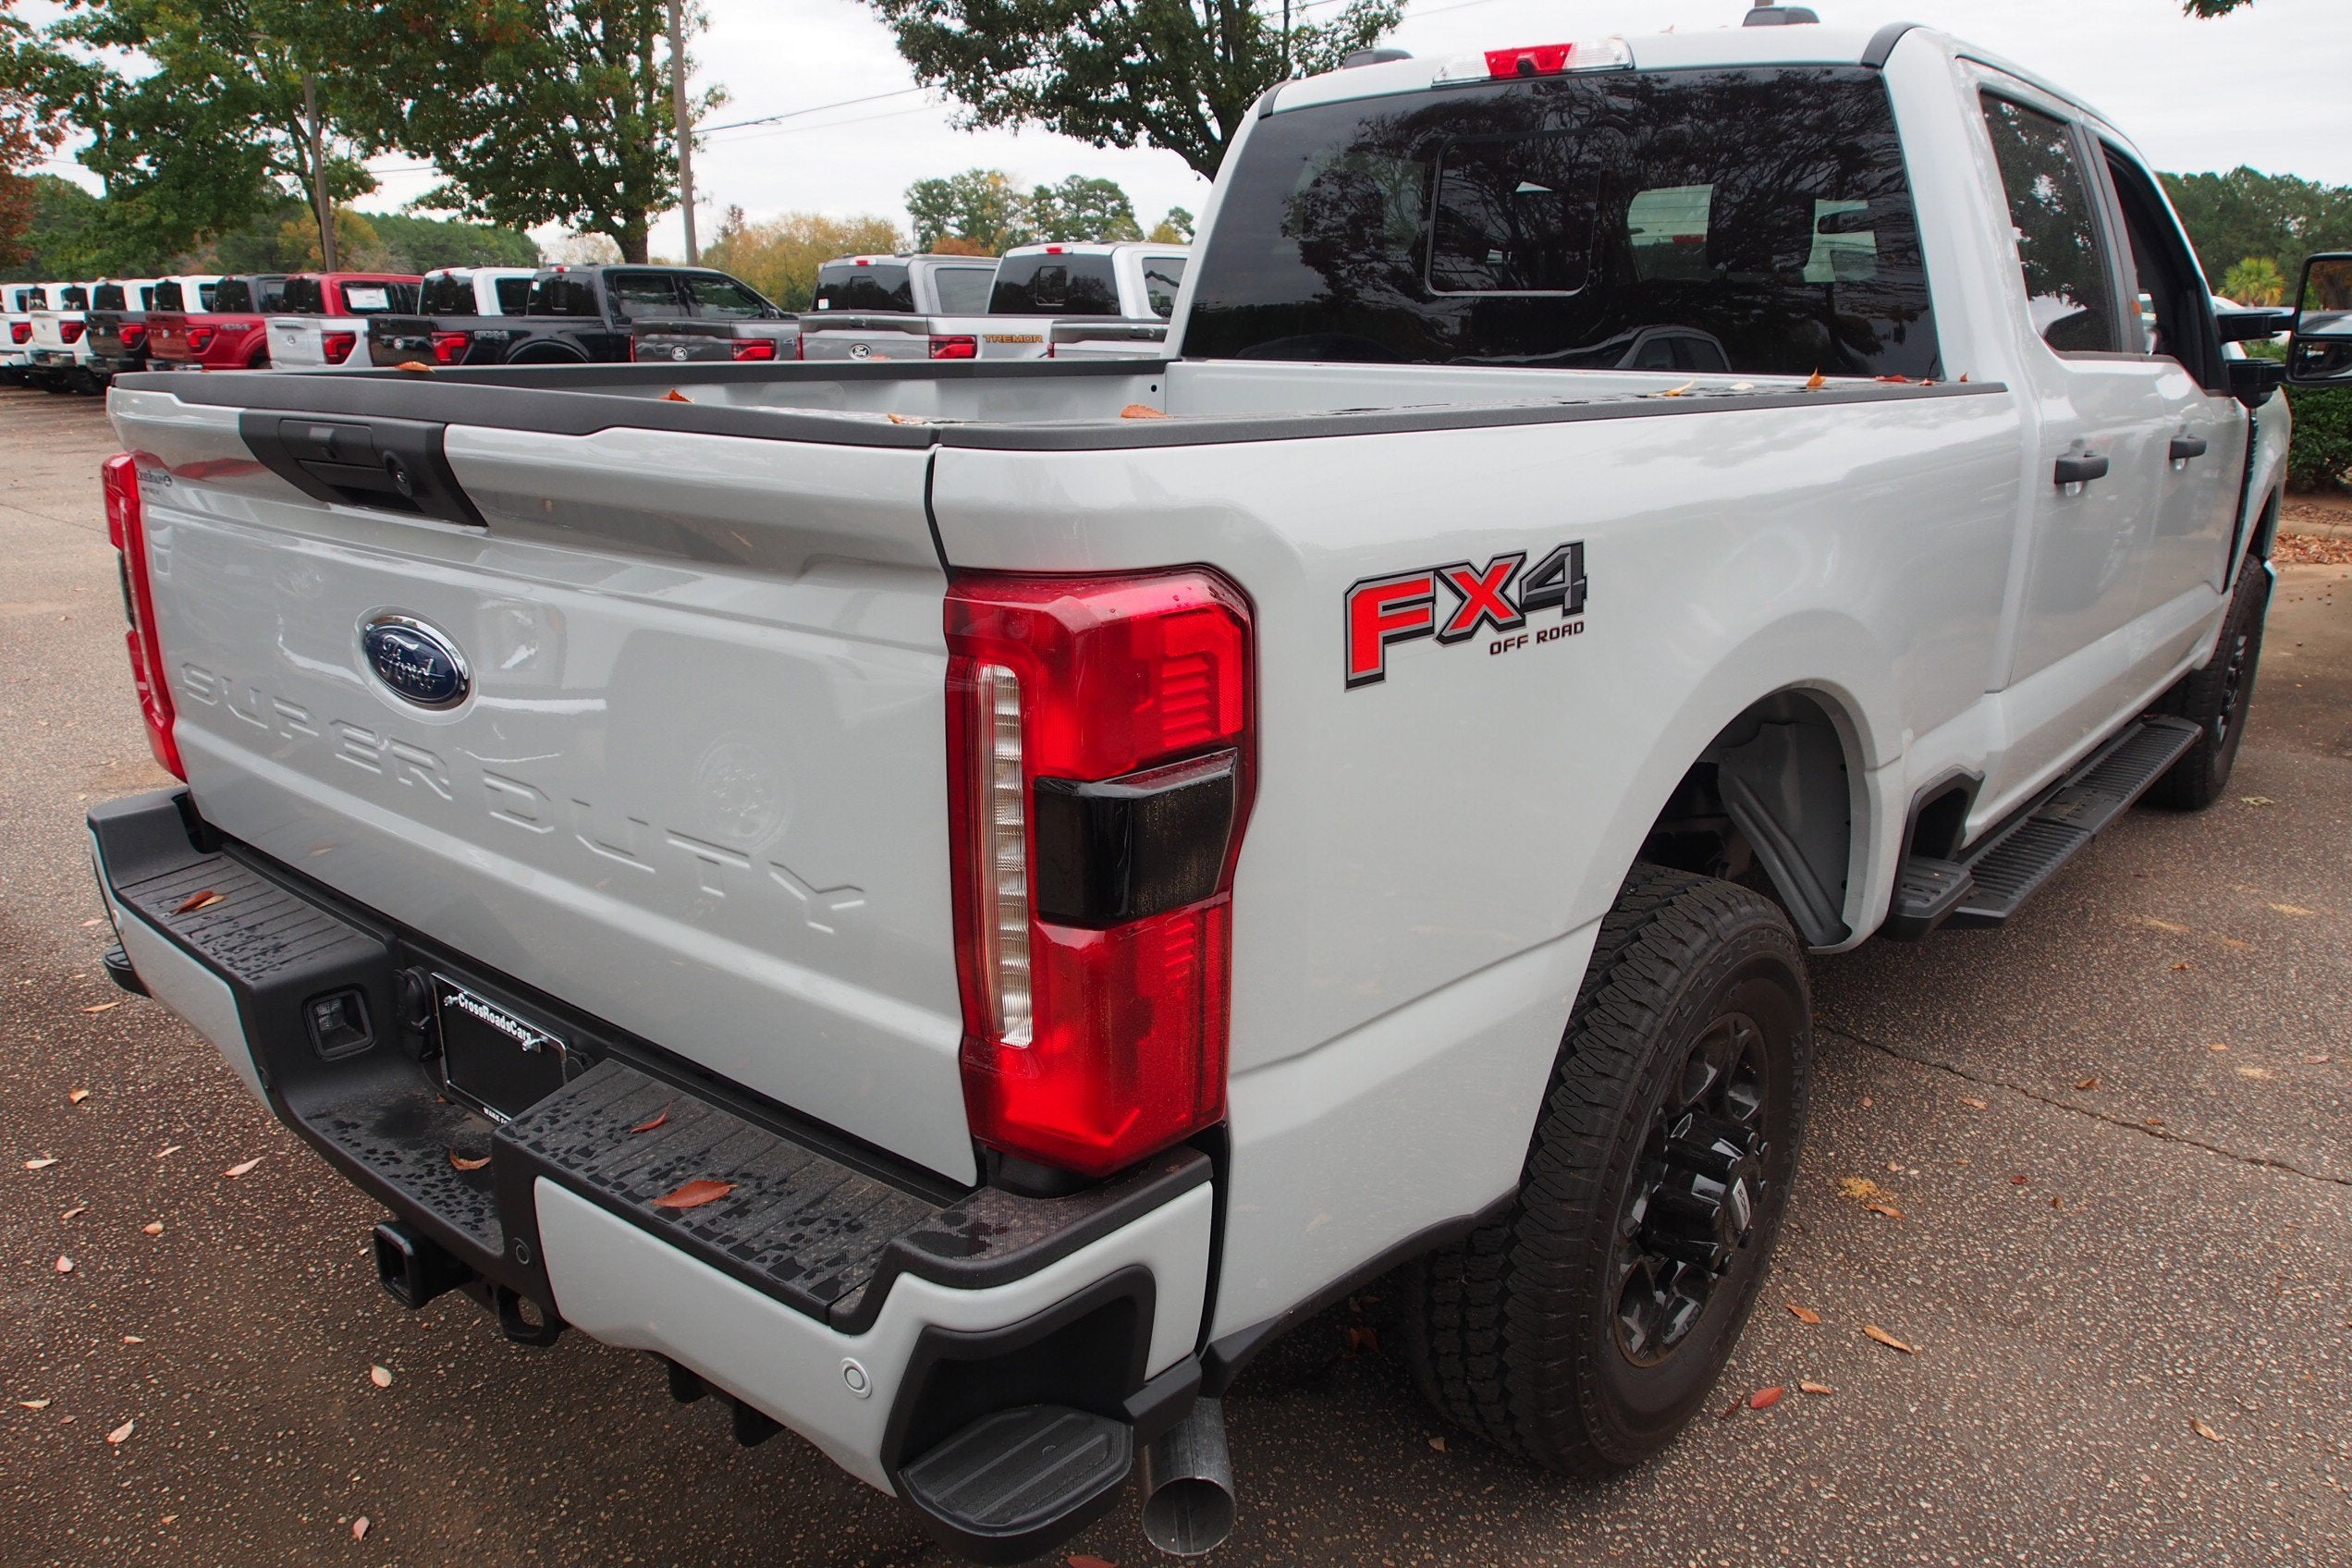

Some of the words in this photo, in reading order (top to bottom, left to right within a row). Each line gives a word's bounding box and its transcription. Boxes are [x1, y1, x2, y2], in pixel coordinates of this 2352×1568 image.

[983, 334, 1044, 344] TREMOR
[1343, 539, 1587, 692] FX4
[1489, 634, 1529, 655] OFF
[1536, 621, 1585, 644] ROAD
[377, 633, 443, 692] Ford
[179, 661, 453, 802] SUPER
[482, 768, 865, 935] DUTY
[458, 992, 532, 1042] CrossRoadsCars
